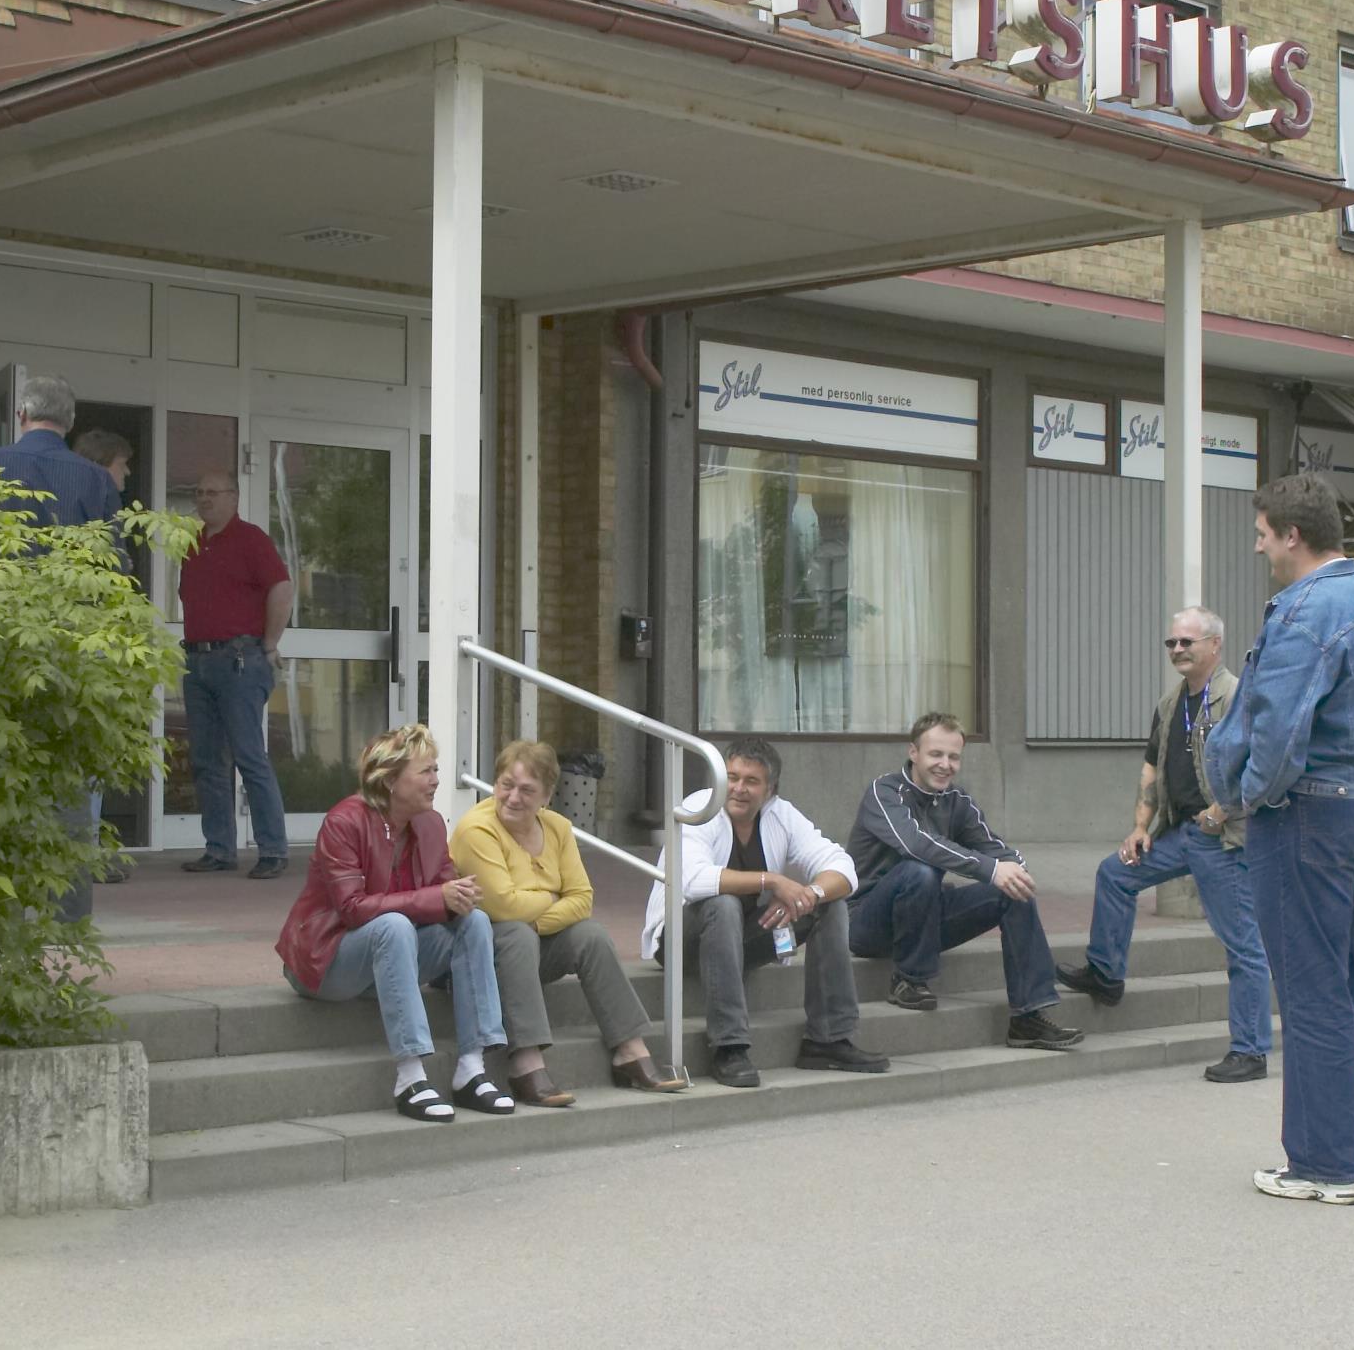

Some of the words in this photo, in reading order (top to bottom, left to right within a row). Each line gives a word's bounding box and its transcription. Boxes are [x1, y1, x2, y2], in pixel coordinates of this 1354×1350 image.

[714, 360, 762, 411] Stil
[801, 385, 823, 397] med
[827, 388, 873, 404] personlig
[877, 395, 912, 407] service
[1038, 403, 1074, 451] Stil
[1123, 414, 1159, 458] Stil
[1220, 438, 1241, 449] mode
